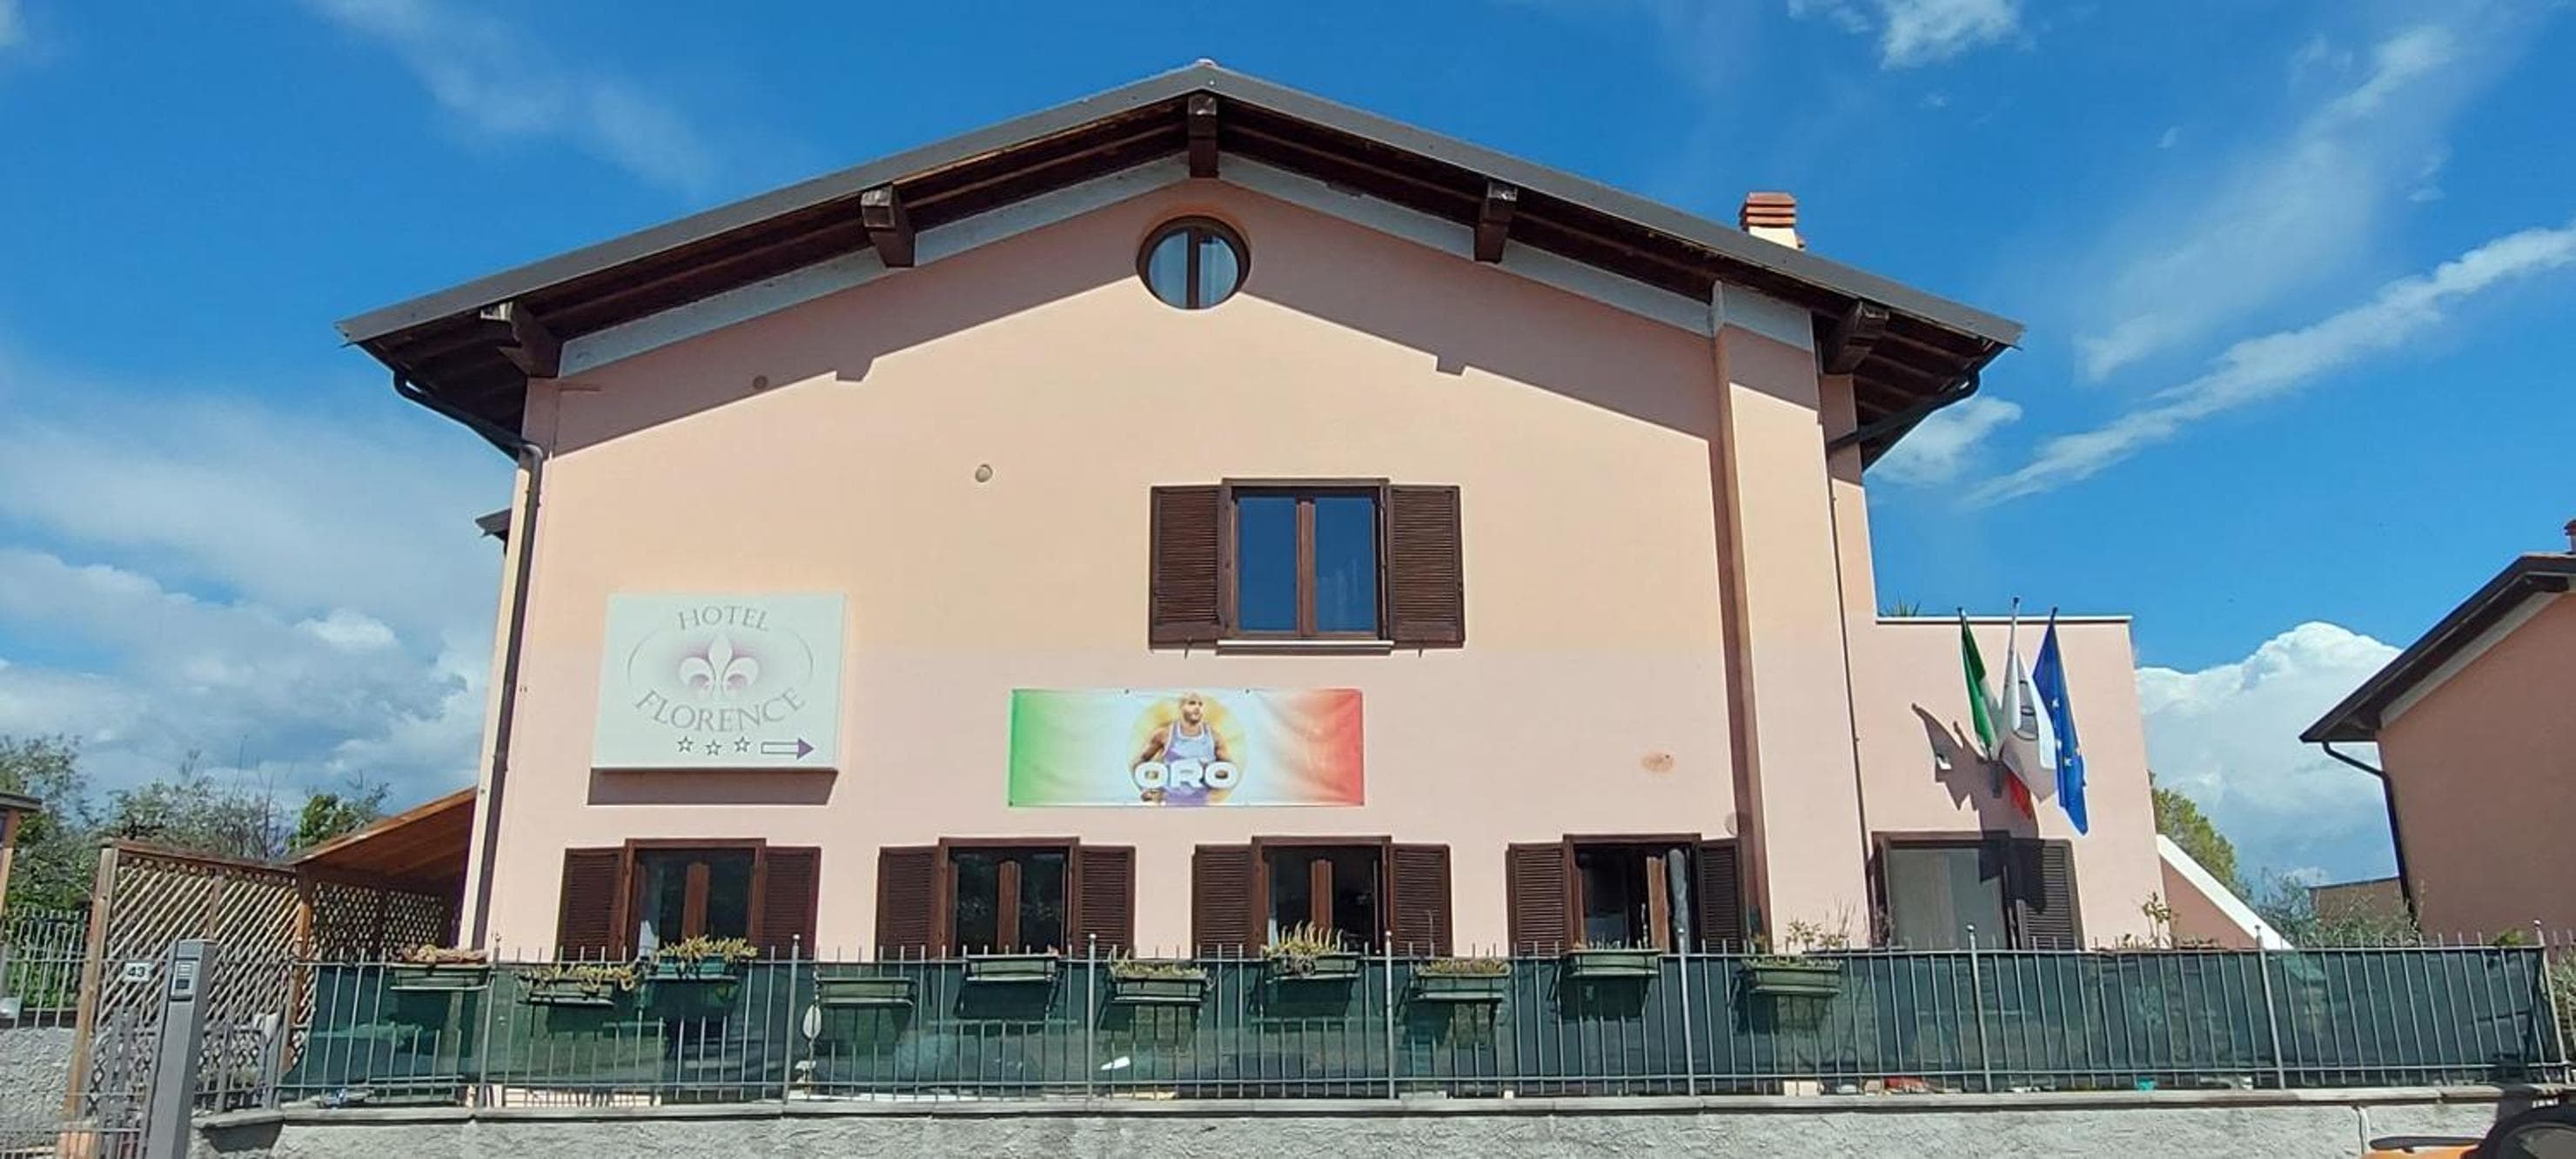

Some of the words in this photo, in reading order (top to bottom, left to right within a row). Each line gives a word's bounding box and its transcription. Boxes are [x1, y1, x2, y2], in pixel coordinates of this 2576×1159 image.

[678, 605, 769, 632] HOTEL
[634, 687, 806, 734] FLORENCE
[1134, 758, 1238, 789] ORO
[128, 966, 146, 978] 43
